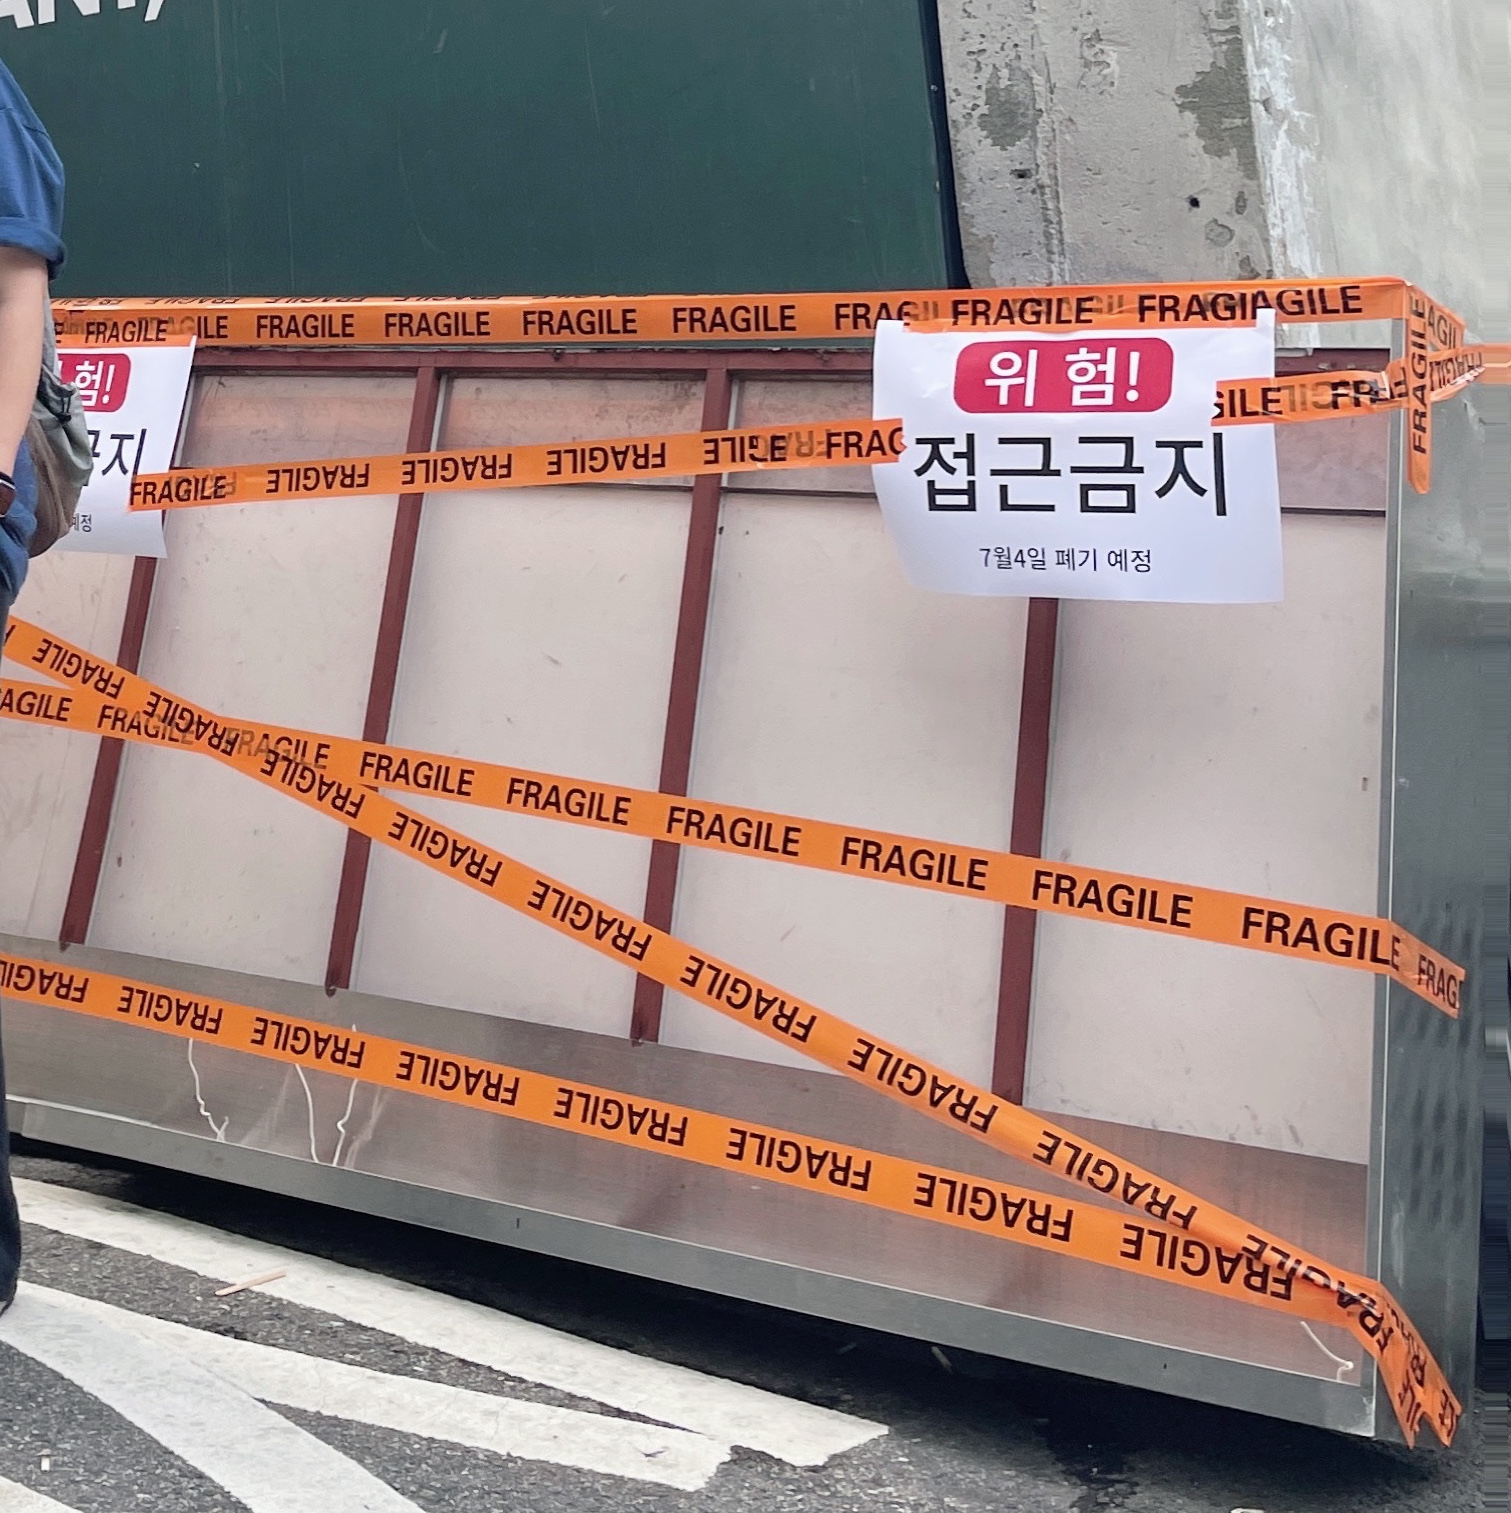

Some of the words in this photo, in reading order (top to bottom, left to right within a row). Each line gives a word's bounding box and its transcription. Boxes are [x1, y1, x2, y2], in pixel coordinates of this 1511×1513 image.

[255, 313, 355, 339] FRAGILE
[383, 310, 491, 338] FRAGILE
[521, 307, 638, 337] FRAGILE
[671, 304, 797, 334] FRAGILE
[951, 296, 1094, 326] FRAGILE
[1253, 285, 1364, 320] AGILE
[129, 474, 229, 507] FRAGILE
[265, 462, 372, 495] FRAGILE
[400, 453, 514, 487] FRAGILE
[545, 441, 668, 476] FRAGILE
[913, 431, 1230, 518] 접근금지
[978, 545, 1048, 571] 7월4일
[1054, 547, 1098, 573] 폐기
[1107, 547, 1153, 574] 예정
[0, 687, 74, 724] AGILE
[359, 750, 476, 798] FRAGILE
[506, 776, 632, 827] FRAGILE
[666, 805, 803, 859] FRAGILE
[839, 836, 989, 892] FRAGILE
[1031, 868, 1194, 929] FRAGILE
[1240, 905, 1401, 972] FRAGILE
[31, 637, 126, 700] FRAGILE
[142, 690, 240, 758] FRAGILE
[259, 747, 367, 821] FRAGILE
[387, 810, 504, 888] FRAGILE
[526, 879, 654, 963] FRAGILE
[680, 954, 819, 1045] FRAGILE
[847, 1036, 1000, 1135] FRAGILE
[1032, 1129, 1198, 1232] FRAGILE
[0, 959, 90, 1004] FRAGIL
[116, 984, 225, 1036] FRAGILE
[250, 1016, 367, 1070] FRAGILE
[396, 1049, 521, 1108] FRAGILE
[553, 1086, 690, 1148] FRAGILE
[725, 1126, 873, 1193] FRAGILE
[913, 1170, 1076, 1243] FRAGILE
[1118, 1221, 1296, 1302] FRAGILE
